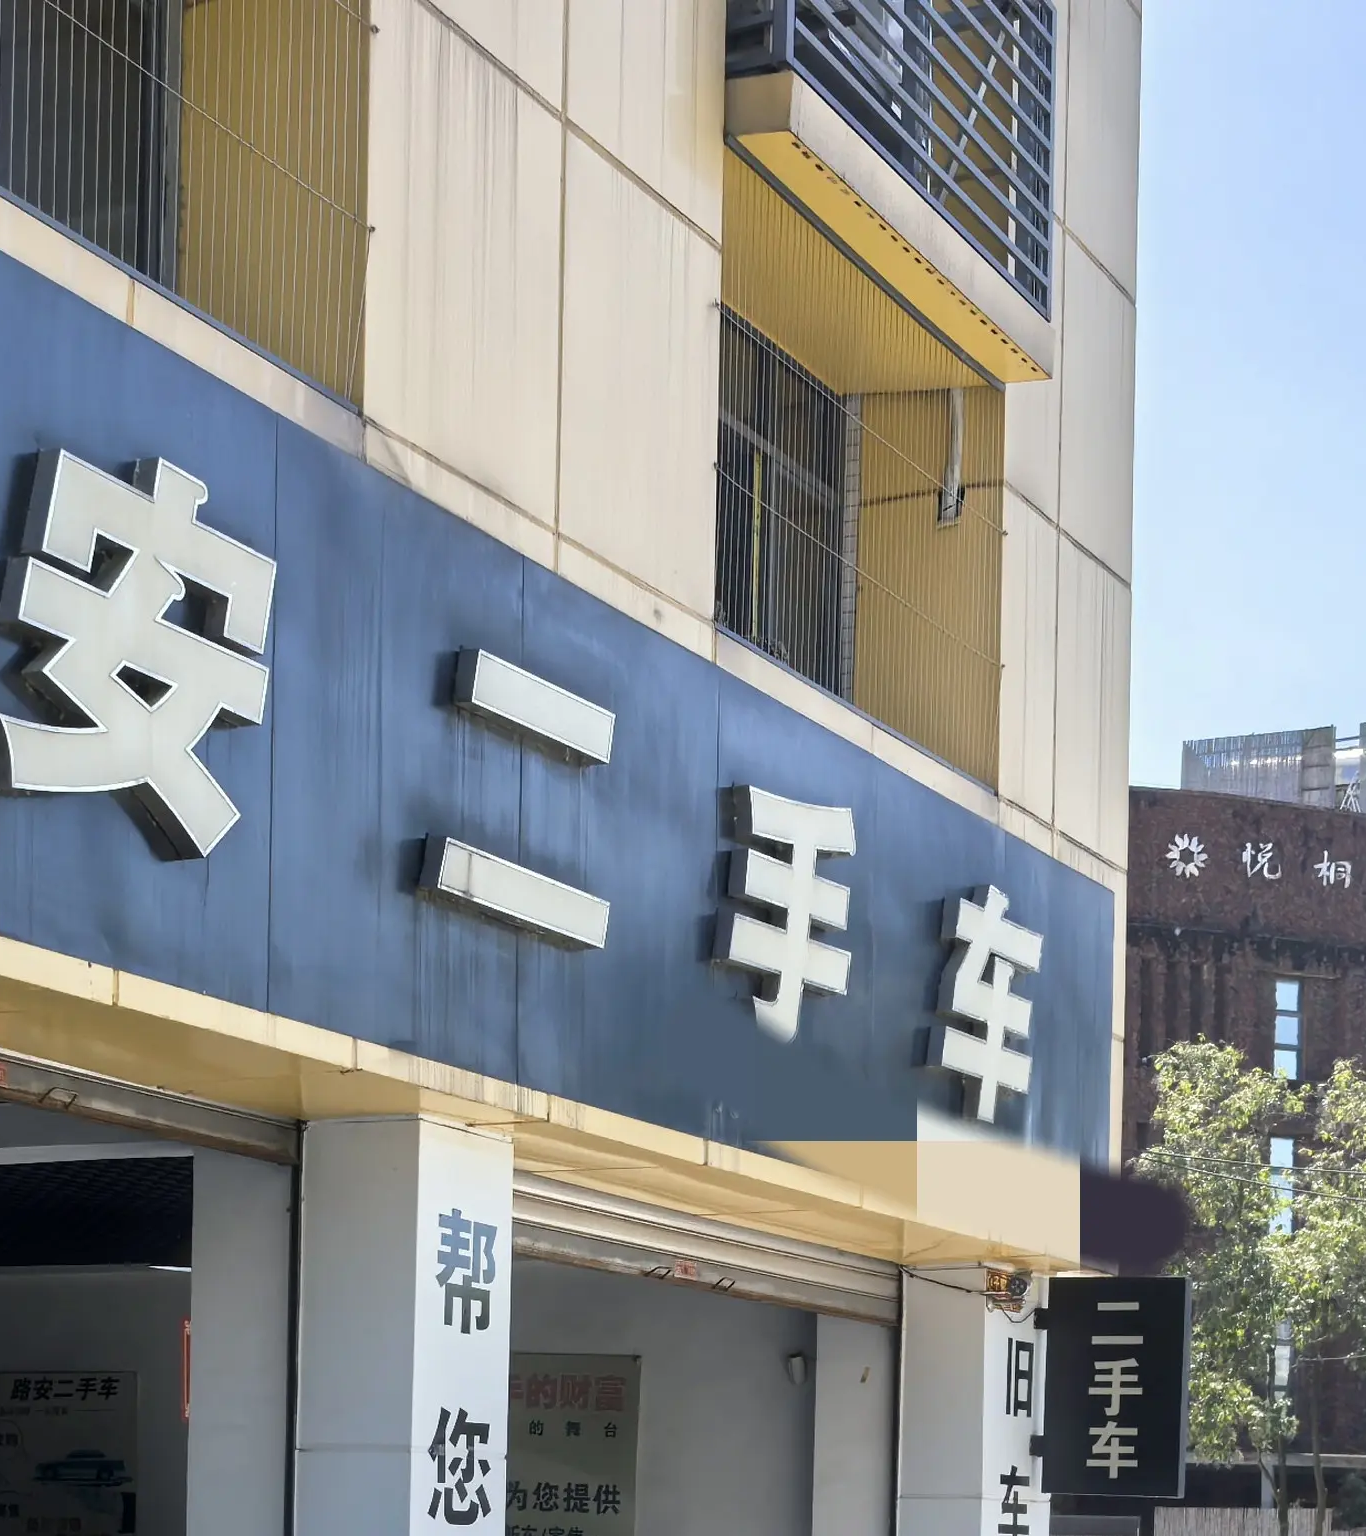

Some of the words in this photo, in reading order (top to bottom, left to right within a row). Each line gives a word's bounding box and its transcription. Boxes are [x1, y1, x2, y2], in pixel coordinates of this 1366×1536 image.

[10, 1376, 120, 1401] 路安二手车
[1085, 1302, 1144, 1480] 二手车
